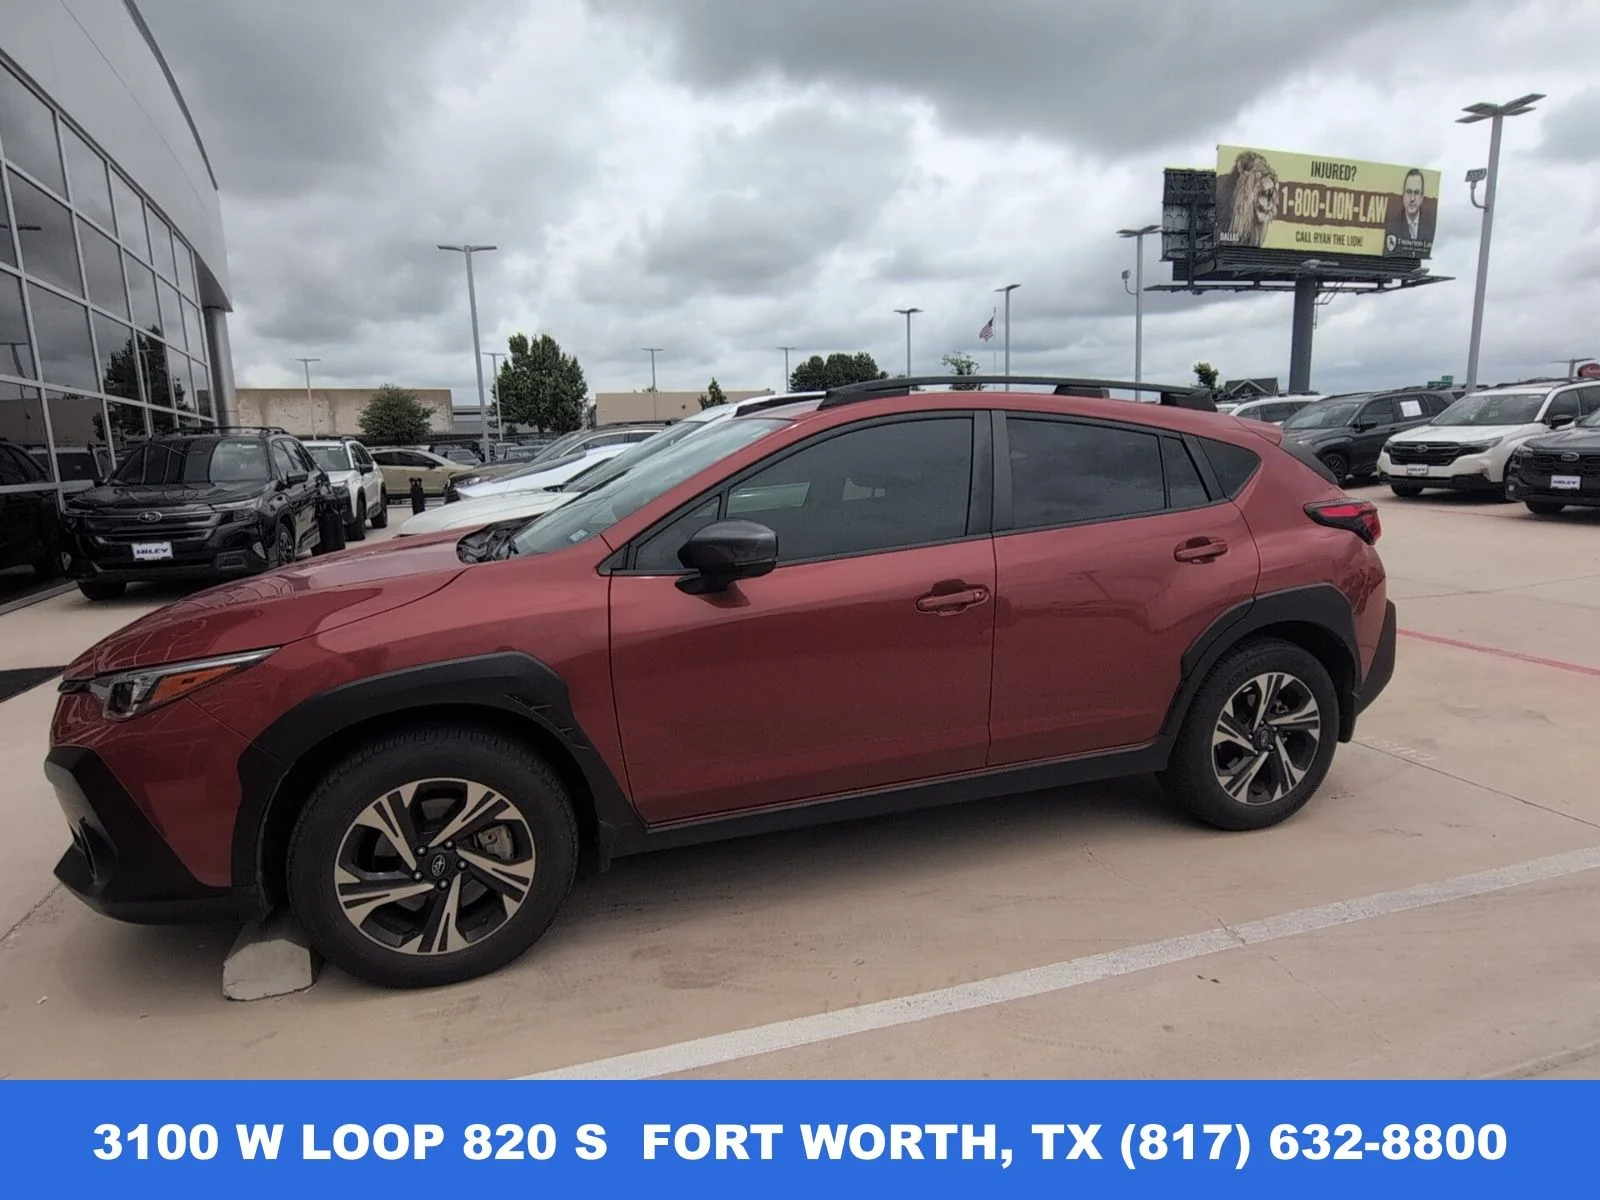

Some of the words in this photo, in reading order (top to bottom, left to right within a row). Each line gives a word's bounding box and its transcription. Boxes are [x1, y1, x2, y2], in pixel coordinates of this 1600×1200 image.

[1310, 160, 1357, 182] INJURED?
[1282, 186, 1389, 223] 1-800-LION-LAW
[1295, 230, 1312, 243] CALL
[1313, 231, 1332, 244] RYAN
[1333, 233, 1346, 246] THE
